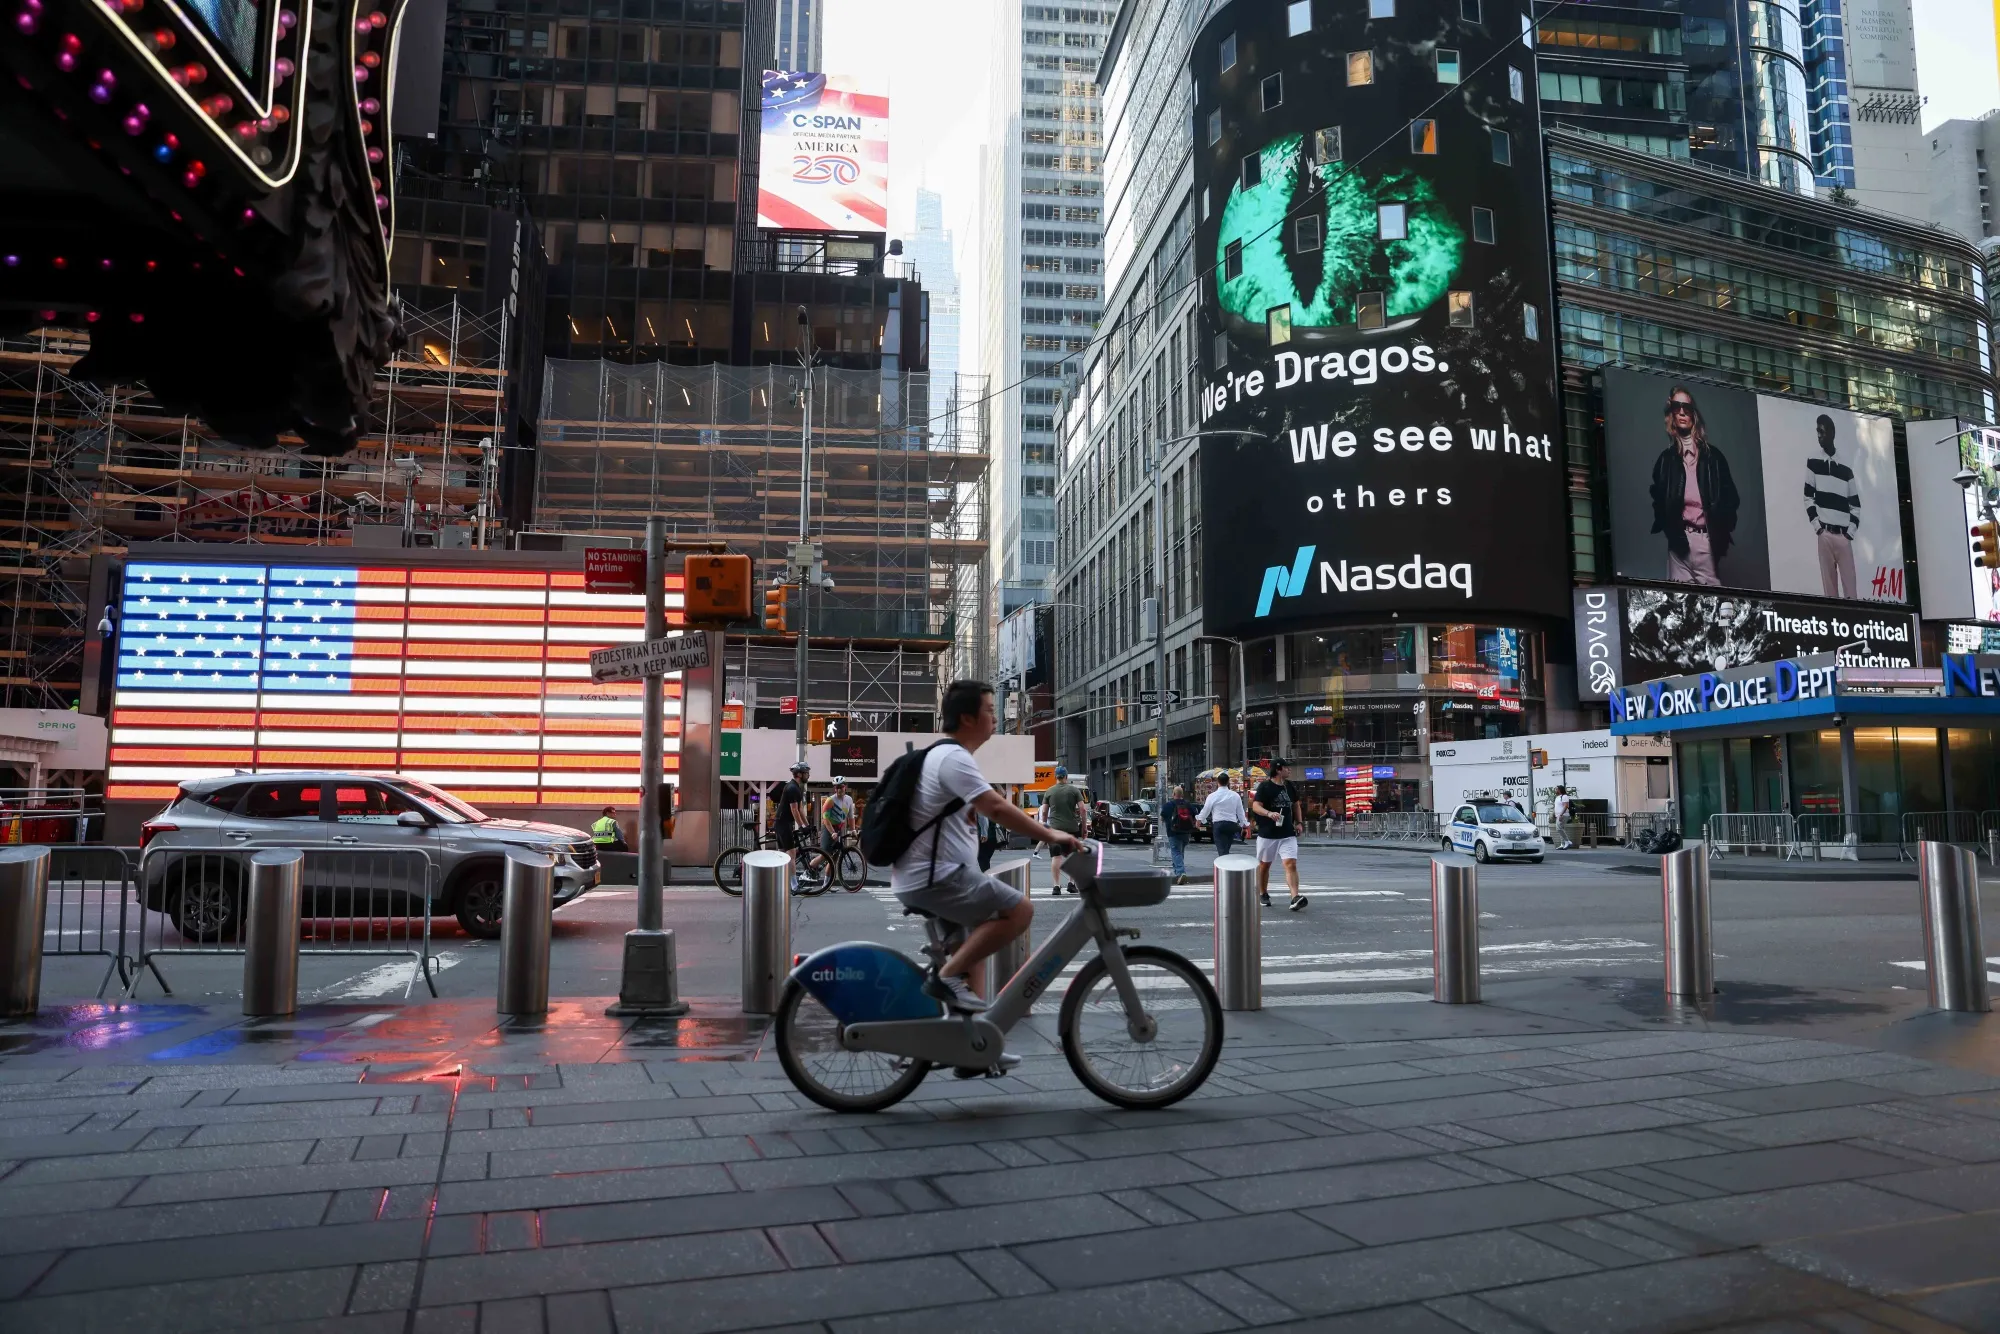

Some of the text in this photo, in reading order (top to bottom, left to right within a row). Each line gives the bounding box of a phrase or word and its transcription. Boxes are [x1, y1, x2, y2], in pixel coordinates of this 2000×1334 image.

[1861, 10, 1894, 18] NATURAL
[794, 141, 858, 153] AMERICA
[793, 155, 860, 186] 250
[1201, 344, 1449, 424] We're Dragos.
[1290, 423, 1552, 464] We see what
[1306, 485, 1452, 513] others
[588, 552, 642, 563] NO STANDING
[589, 562, 623, 574] Anytime
[1320, 554, 1473, 599] Nasdaq
[1871, 566, 1903, 600] H&M
[1762, 610, 1909, 642] Threats to critical
[592, 634, 706, 666] PEDESTRIAN FLOW ZONE
[1586, 593, 1616, 695] DRAGOS
[644, 651, 707, 674] KEEP MOVING
[1609, 660, 1837, 723] NEW YORK POLICE DEPT
[38, 722, 76, 730] SPRING
[1346, 740, 1376, 749] Nasdaq
[1582, 739, 1609, 749] indeed
[1436, 750, 1446, 758] FOX
[1503, 777, 1517, 786] FOX
[1517, 788, 1529, 798] CU
[1461, 831, 1473, 843] NYPD
[811, 966, 866, 981] citi bike
